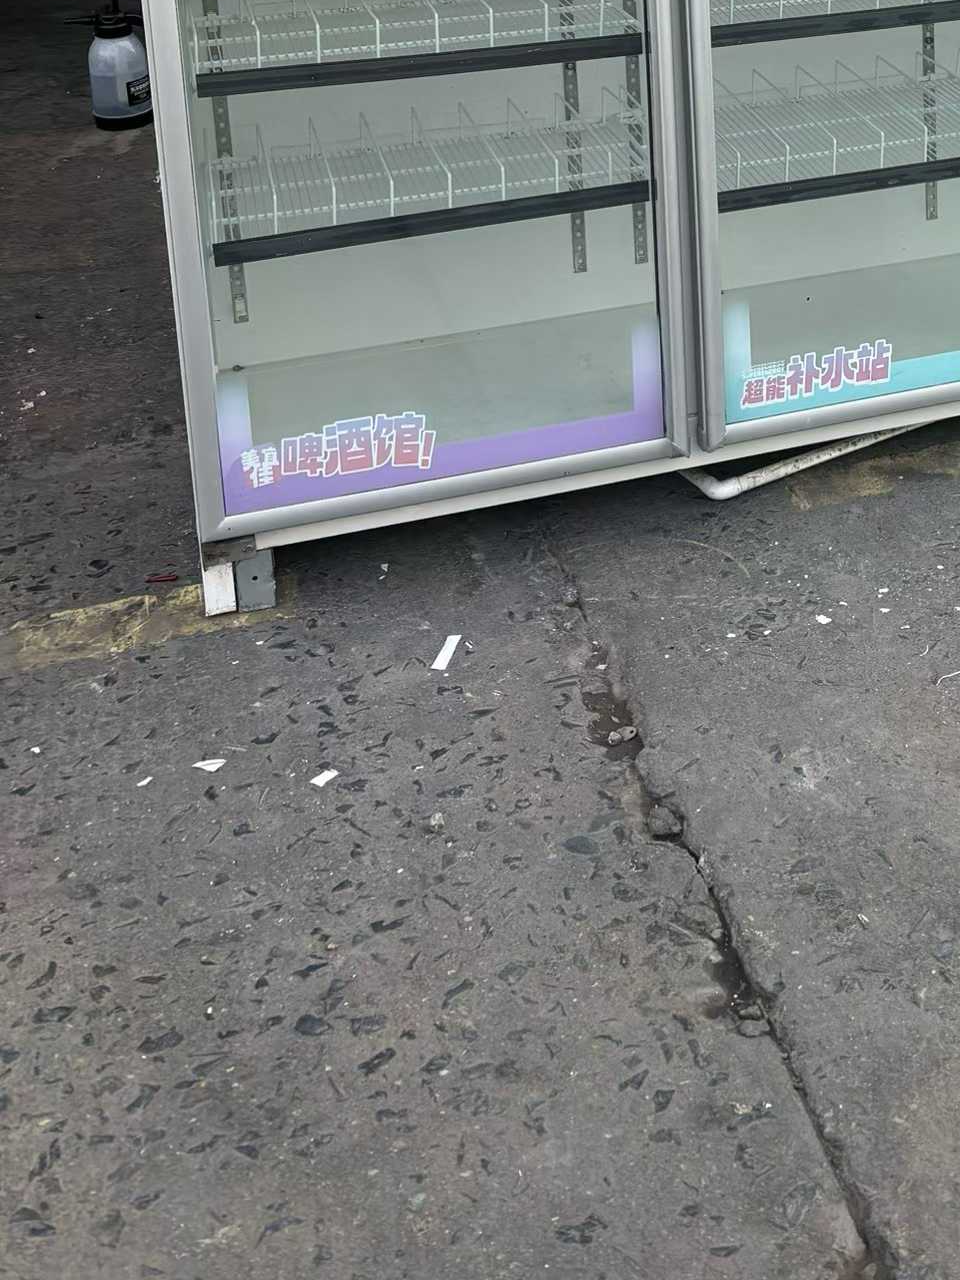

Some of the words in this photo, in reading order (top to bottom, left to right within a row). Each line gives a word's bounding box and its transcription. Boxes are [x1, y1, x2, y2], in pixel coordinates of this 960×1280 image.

[740, 339, 892, 410] 超能补水站
